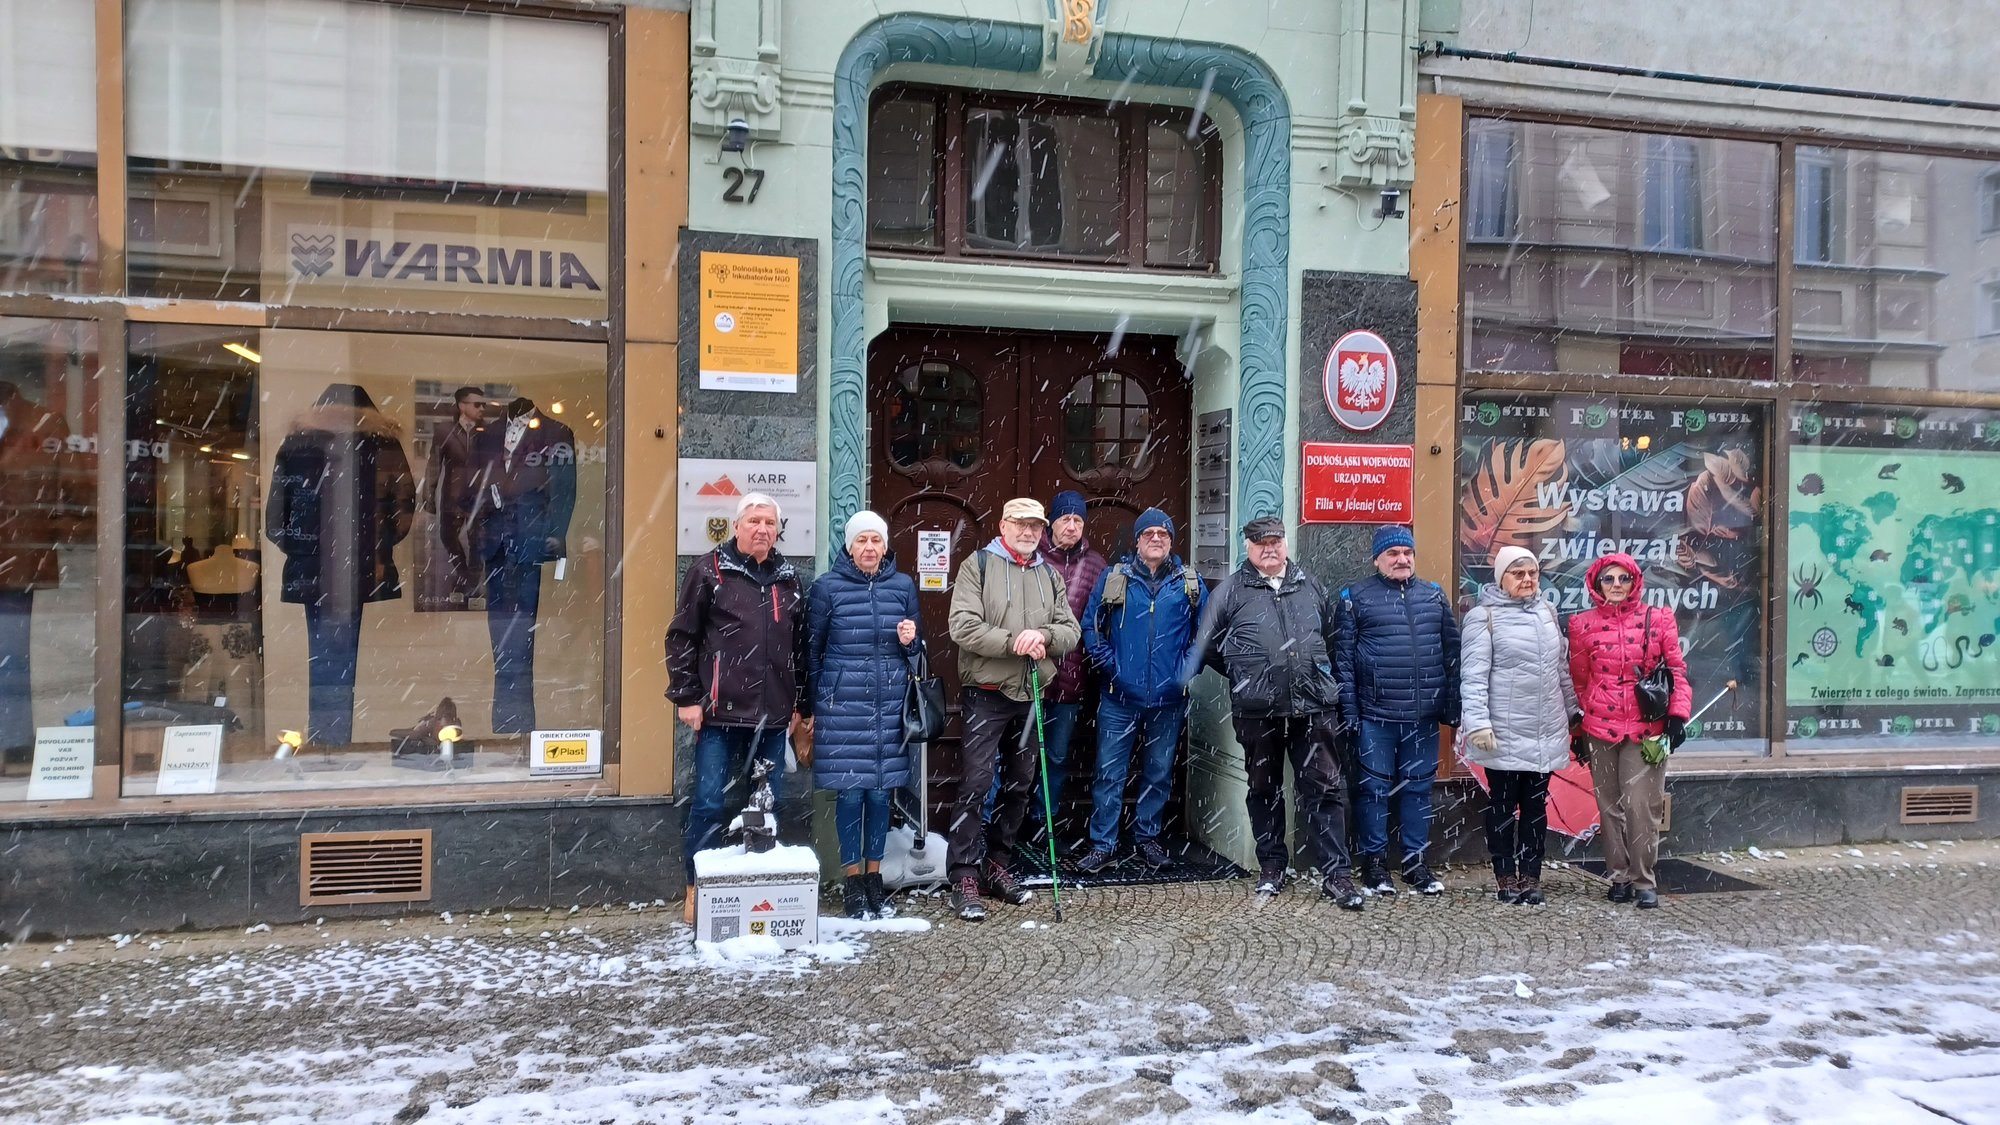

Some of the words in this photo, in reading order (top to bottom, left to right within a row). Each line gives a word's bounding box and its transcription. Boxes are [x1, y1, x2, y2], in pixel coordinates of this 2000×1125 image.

[723, 167, 764, 203] 27
[345, 239, 602, 291] WARMIA
[1307, 454, 1360, 468] DOLNOŚLĄSKI
[1362, 455, 1410, 468] WOJEWÓDZKI
[747, 473, 787, 484] KARR
[1334, 473, 1360, 485] URZĄD
[1362, 473, 1386, 484] PRACY
[1315, 497, 1334, 510] Filia
[1336, 501, 1343, 509] w
[1345, 498, 1375, 513] Jeleniej
[1377, 498, 1402, 511] Górze
[1537, 481, 1684, 517] Wystawa
[1539, 531, 1681, 566] zwierząt
[1811, 686, 1862, 701] Zwierzęta
[1865, 688, 1872, 698] z
[1875, 685, 1910, 700] całego
[711, 896, 740, 904] BAJKA
[777, 896, 799, 904] KARR
[770, 919, 806, 929] DOLNY
[770, 927, 803, 938] ŚLĄSK
